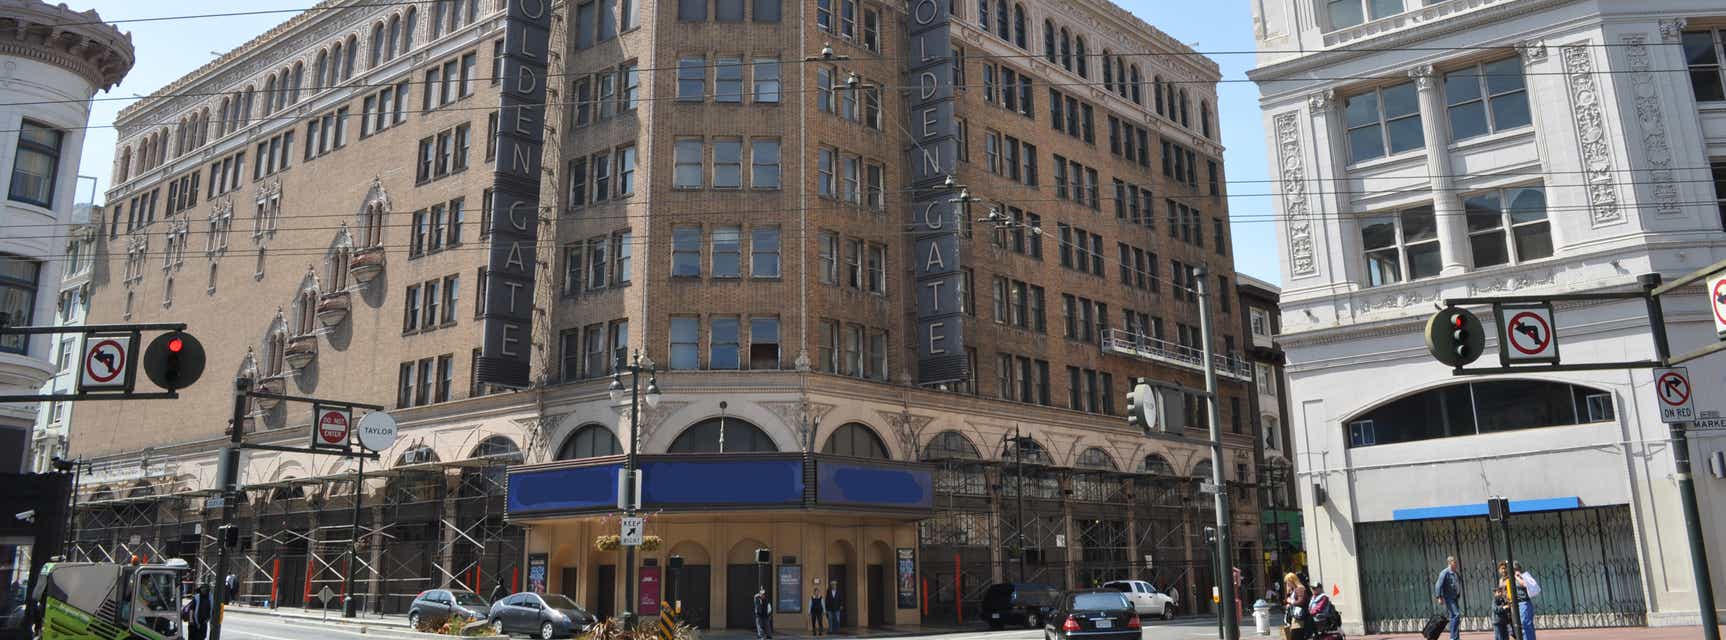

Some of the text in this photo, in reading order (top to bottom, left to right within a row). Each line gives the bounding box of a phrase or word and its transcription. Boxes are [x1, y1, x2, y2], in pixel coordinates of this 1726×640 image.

[502, 200, 528, 356] GATE
[925, 200, 945, 354] GATE
[1664, 408, 1675, 418] ON
[1677, 408, 1692, 417] RED
[334, 417, 345, 425] NOT
[325, 430, 342, 438] ENTER
[365, 427, 392, 436] TAYLOR
